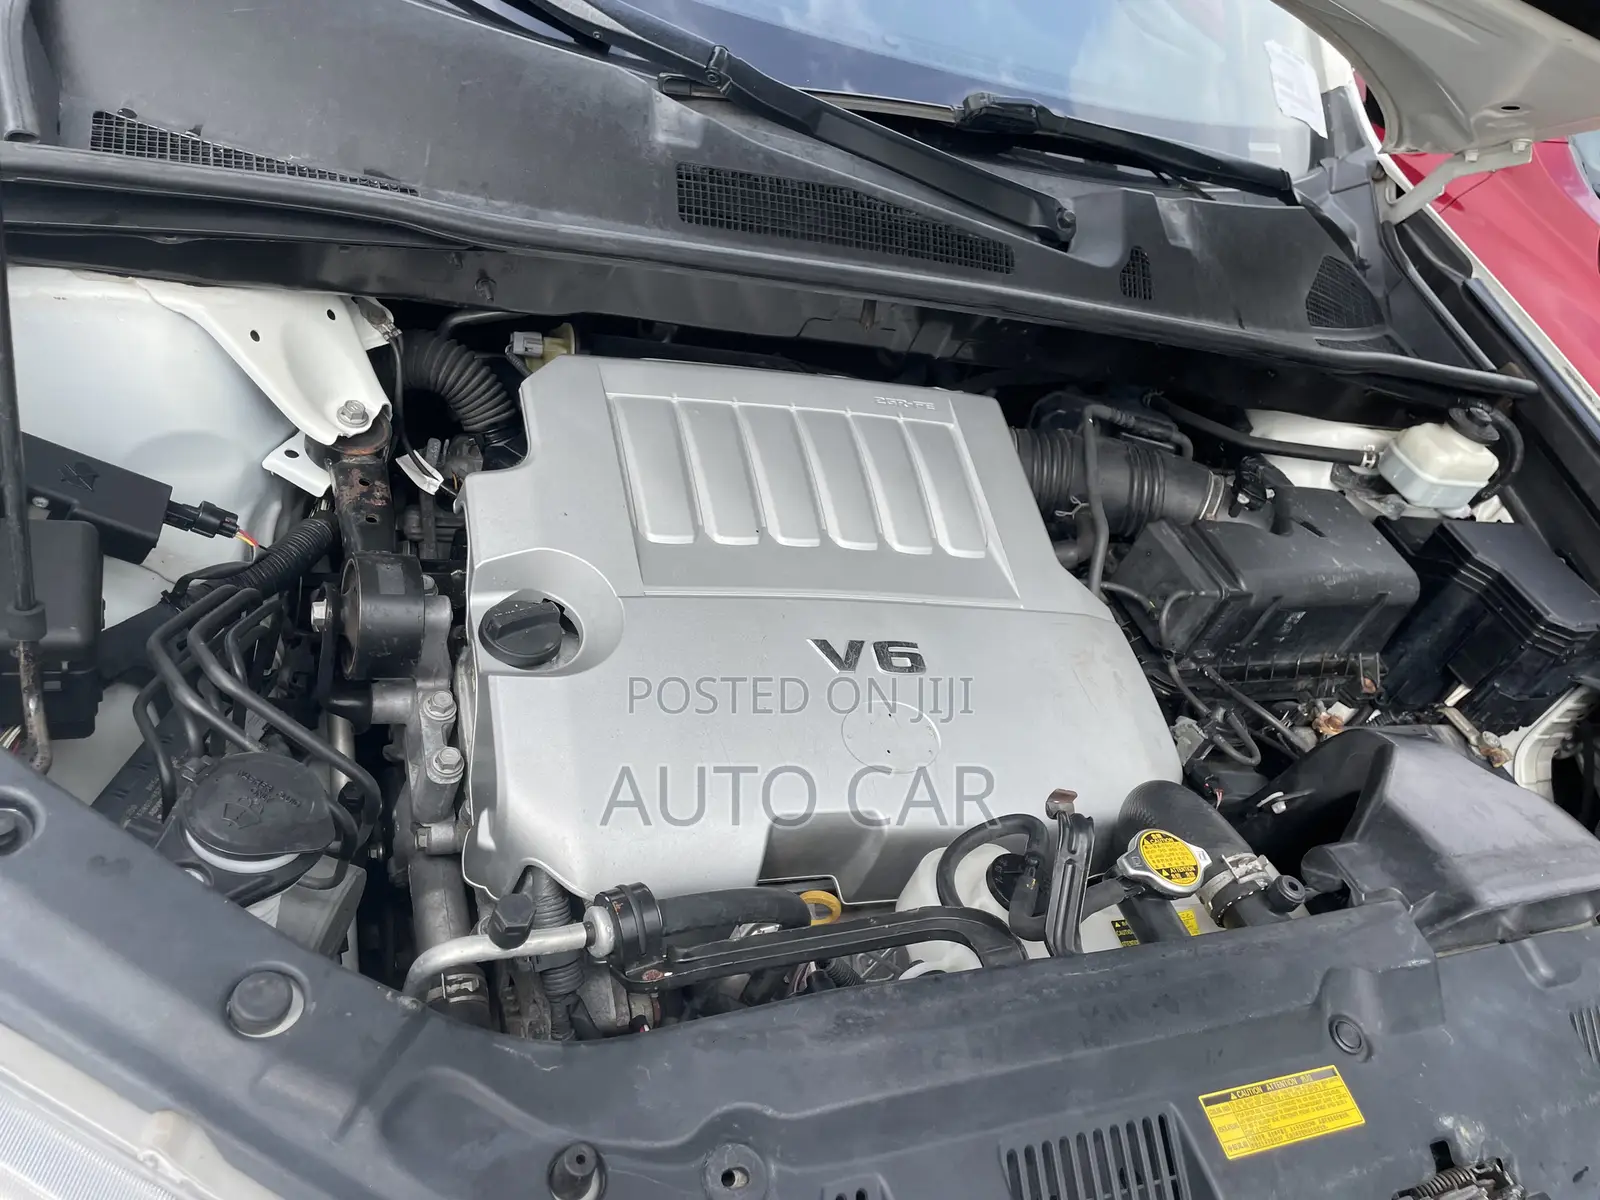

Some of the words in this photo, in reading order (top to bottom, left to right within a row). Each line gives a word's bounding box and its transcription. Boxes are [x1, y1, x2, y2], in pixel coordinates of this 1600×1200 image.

[806, 638, 927, 675] V6
[1236, 1084, 1263, 1098] CAUTION
[1266, 1077, 1297, 1092] ATTENTION
